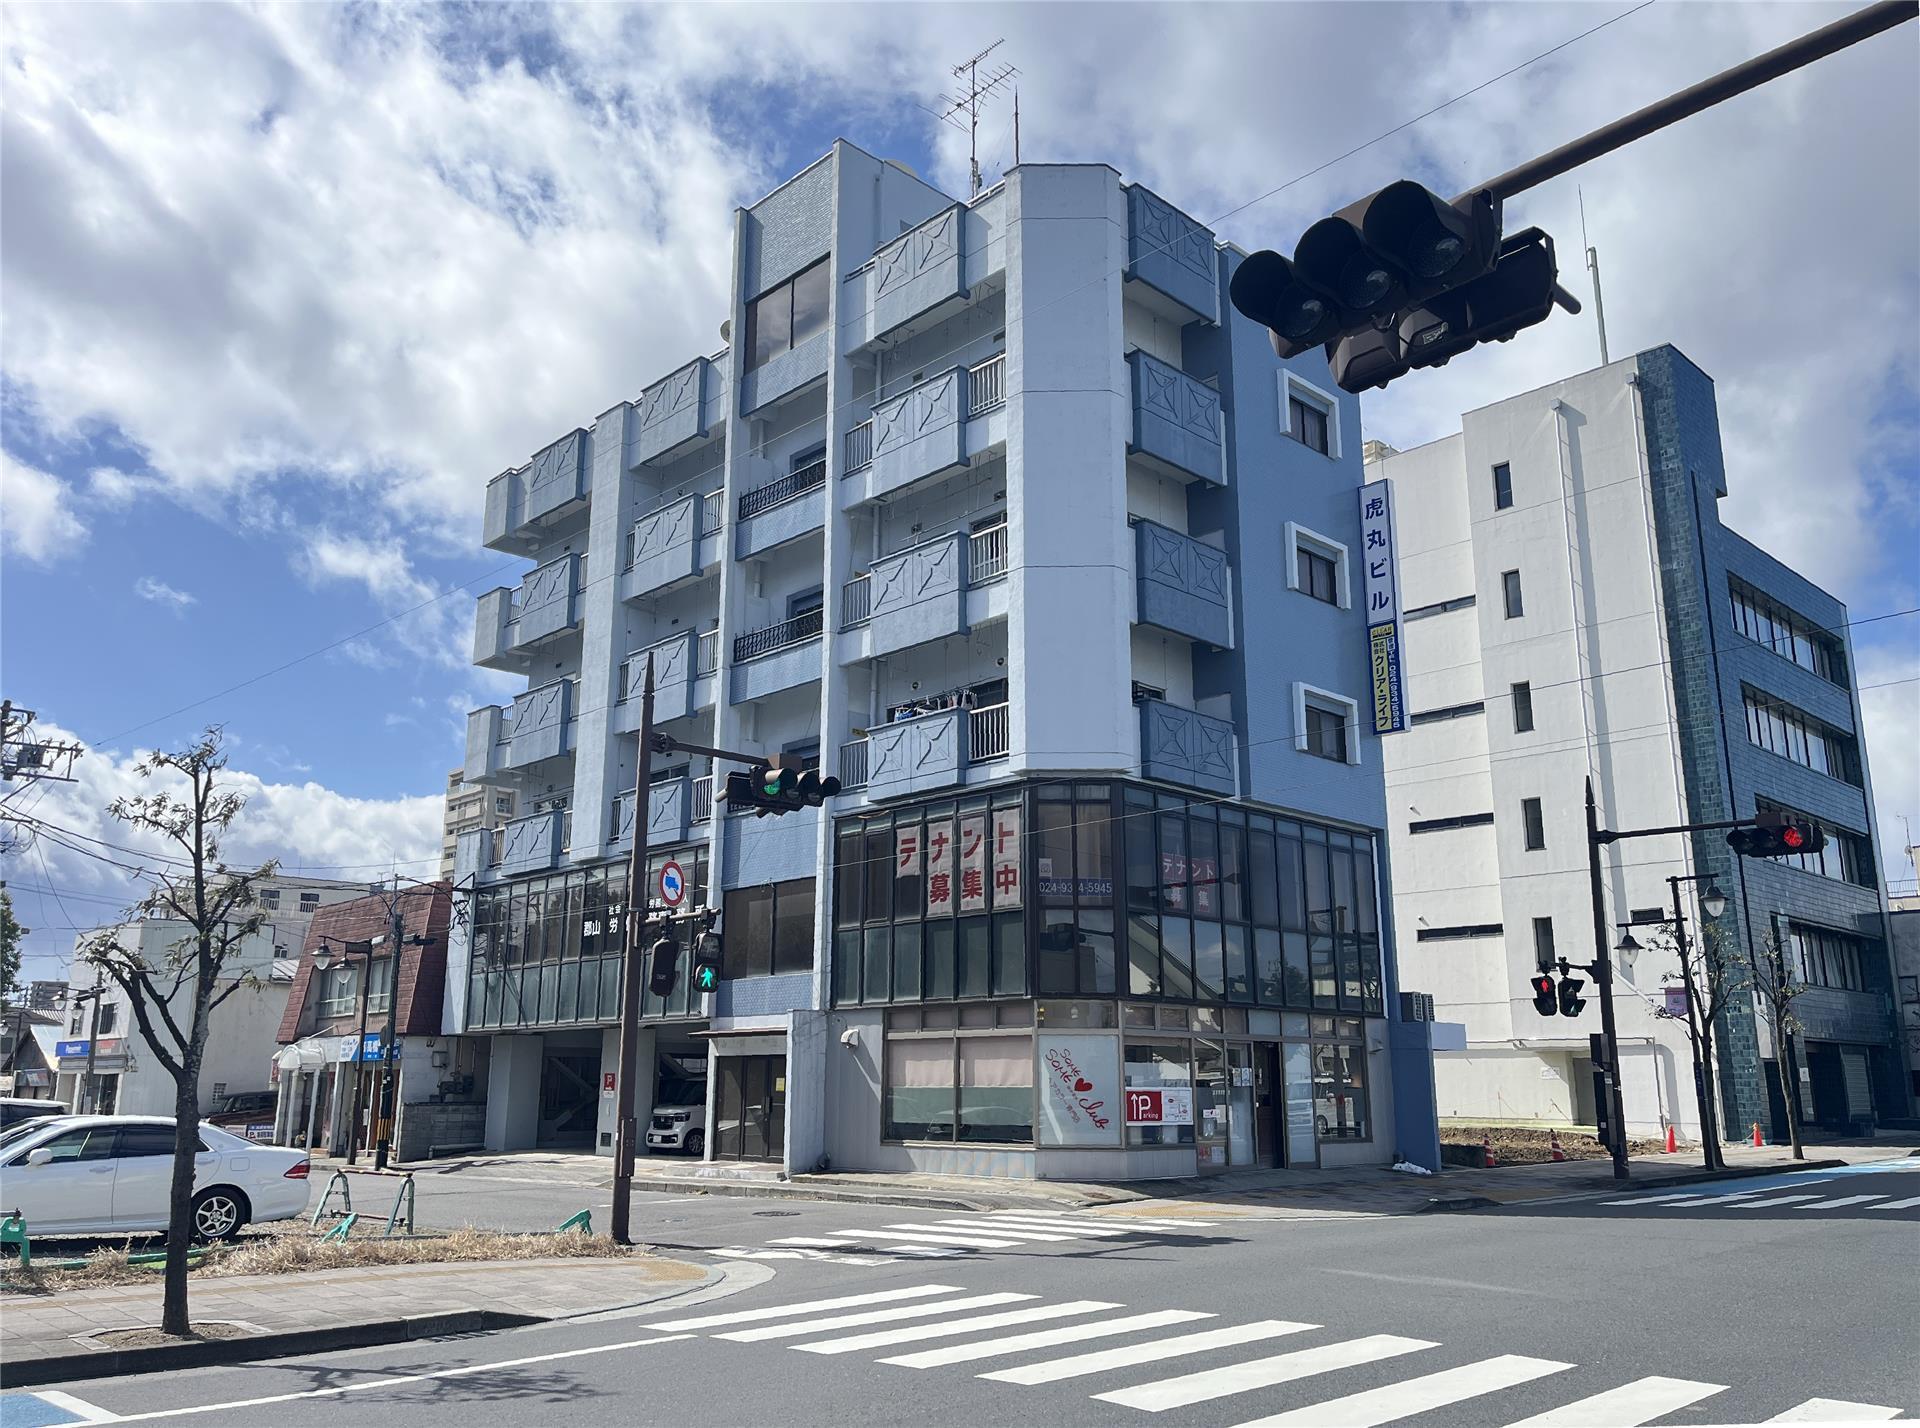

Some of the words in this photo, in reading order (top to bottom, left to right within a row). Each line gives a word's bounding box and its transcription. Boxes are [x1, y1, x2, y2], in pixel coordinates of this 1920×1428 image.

[1364, 497, 1390, 611] 虎丸ビル
[900, 822, 1015, 867] テナント
[929, 864, 1017, 904] 募集中
[1039, 881, 1112, 894] 024-934-5945
[1162, 858, 1214, 881] テナント
